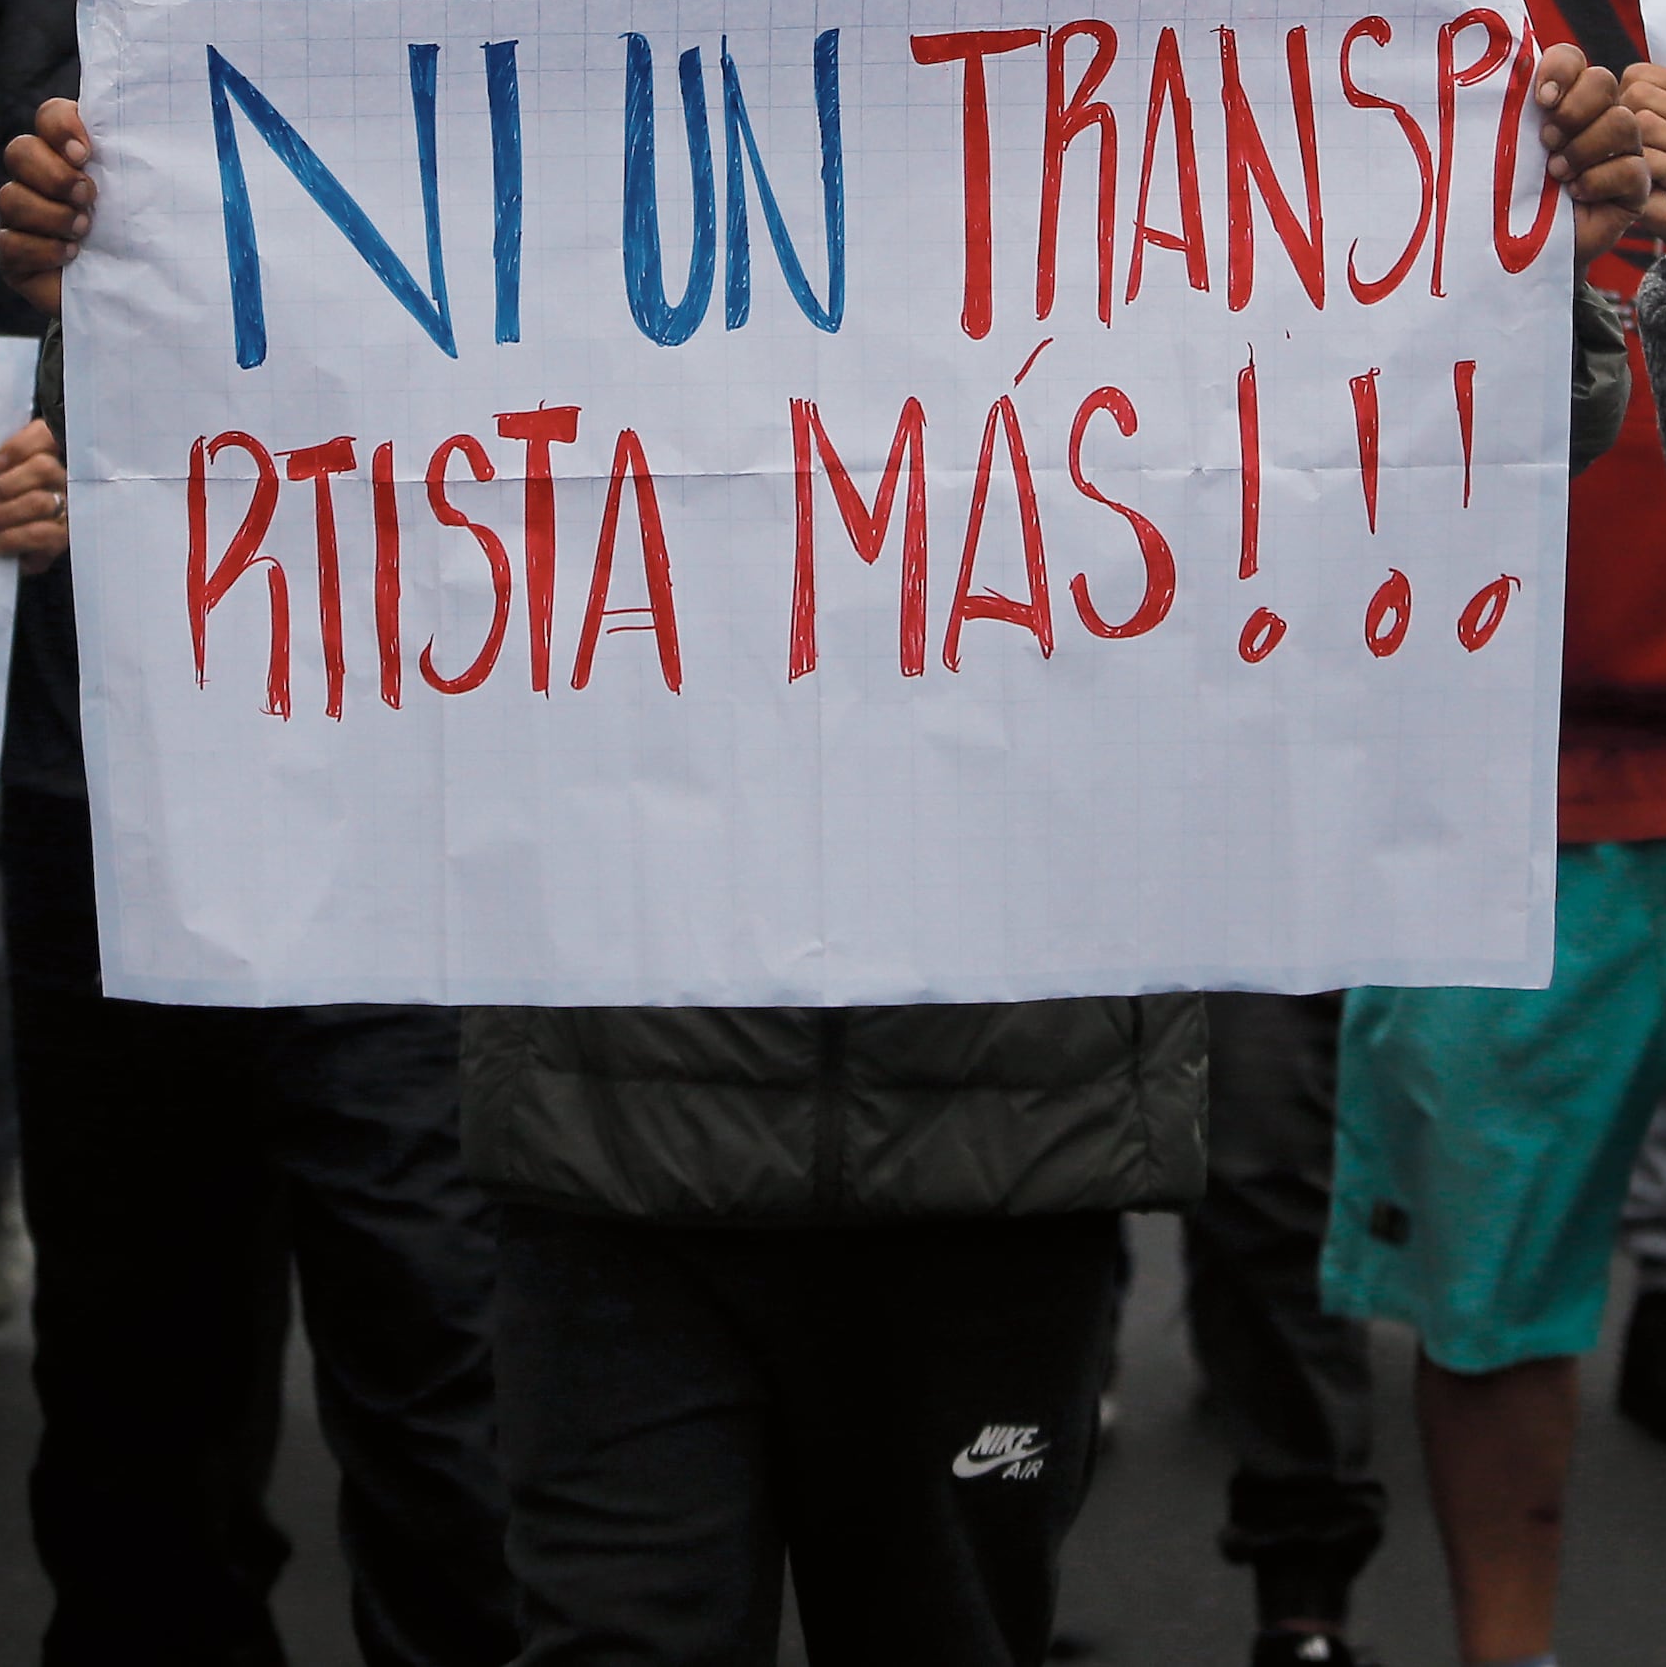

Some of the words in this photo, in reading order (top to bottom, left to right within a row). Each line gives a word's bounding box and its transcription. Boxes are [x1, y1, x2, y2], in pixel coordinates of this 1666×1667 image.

[206, 40, 523, 370] NI
[619, 28, 846, 347] UN
[910, 7, 1561, 339] TRANSPO
[186, 400, 683, 722] RTISTA
[970, 1425, 1040, 1455] NIKE
[1001, 1458, 1044, 1480] AIR
